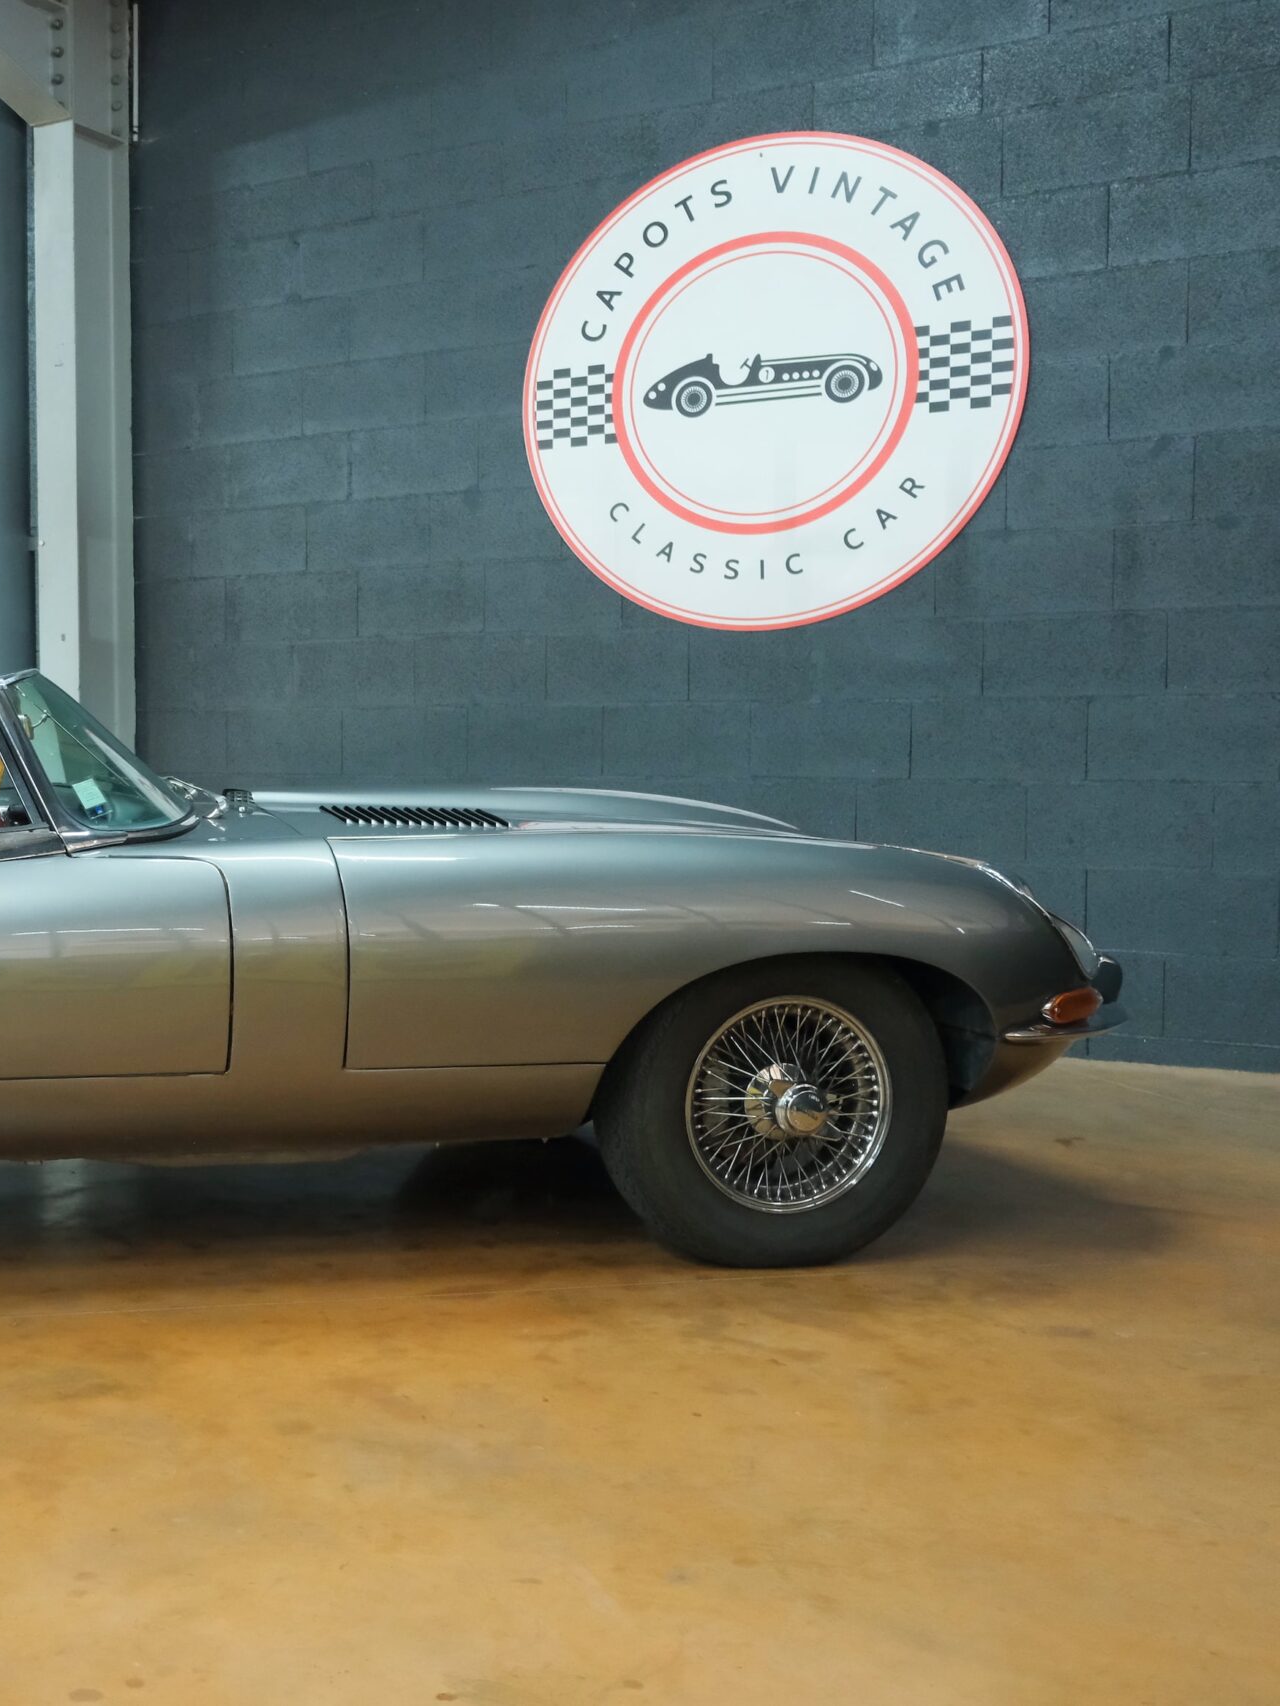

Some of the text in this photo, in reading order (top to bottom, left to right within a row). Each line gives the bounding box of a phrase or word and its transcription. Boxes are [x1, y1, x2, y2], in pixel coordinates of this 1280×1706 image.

[581, 165, 966, 343] CAPOTS VINTAGE
[608, 475, 926, 580] CLASSIC CAR
